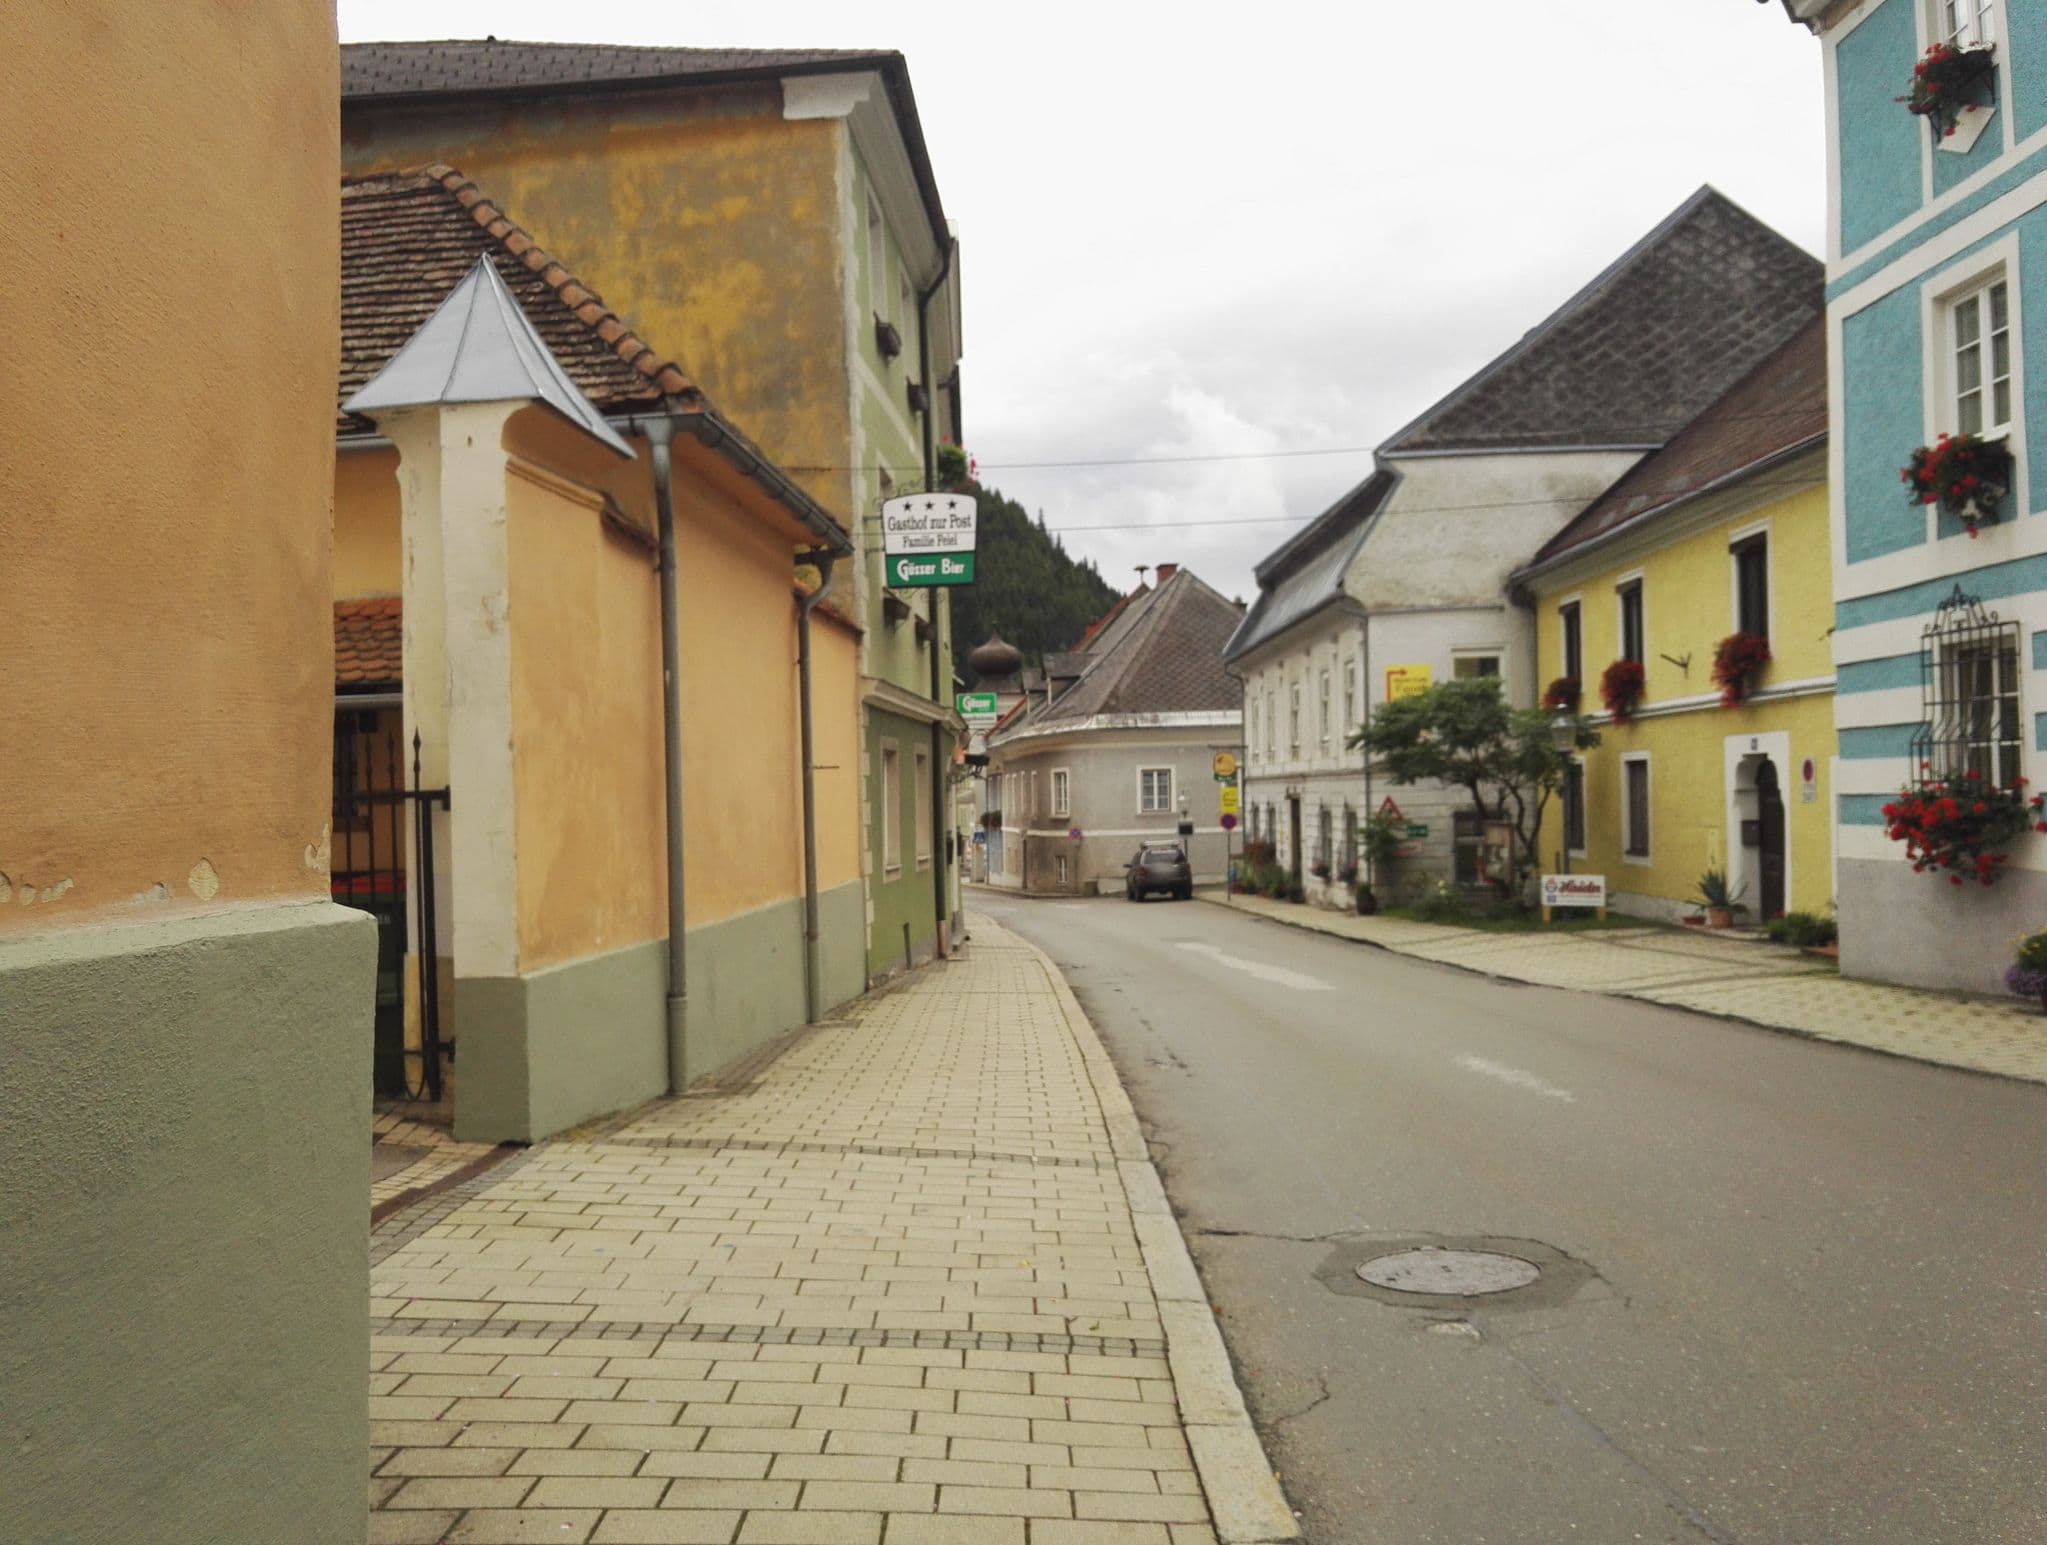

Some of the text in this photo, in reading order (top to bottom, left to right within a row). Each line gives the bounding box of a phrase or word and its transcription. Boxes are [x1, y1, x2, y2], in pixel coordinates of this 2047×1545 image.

[888, 514, 971, 531] Gasthof zur Post
[903, 535, 935, 548] Familie
[897, 558, 965, 581] Gösser Bier
